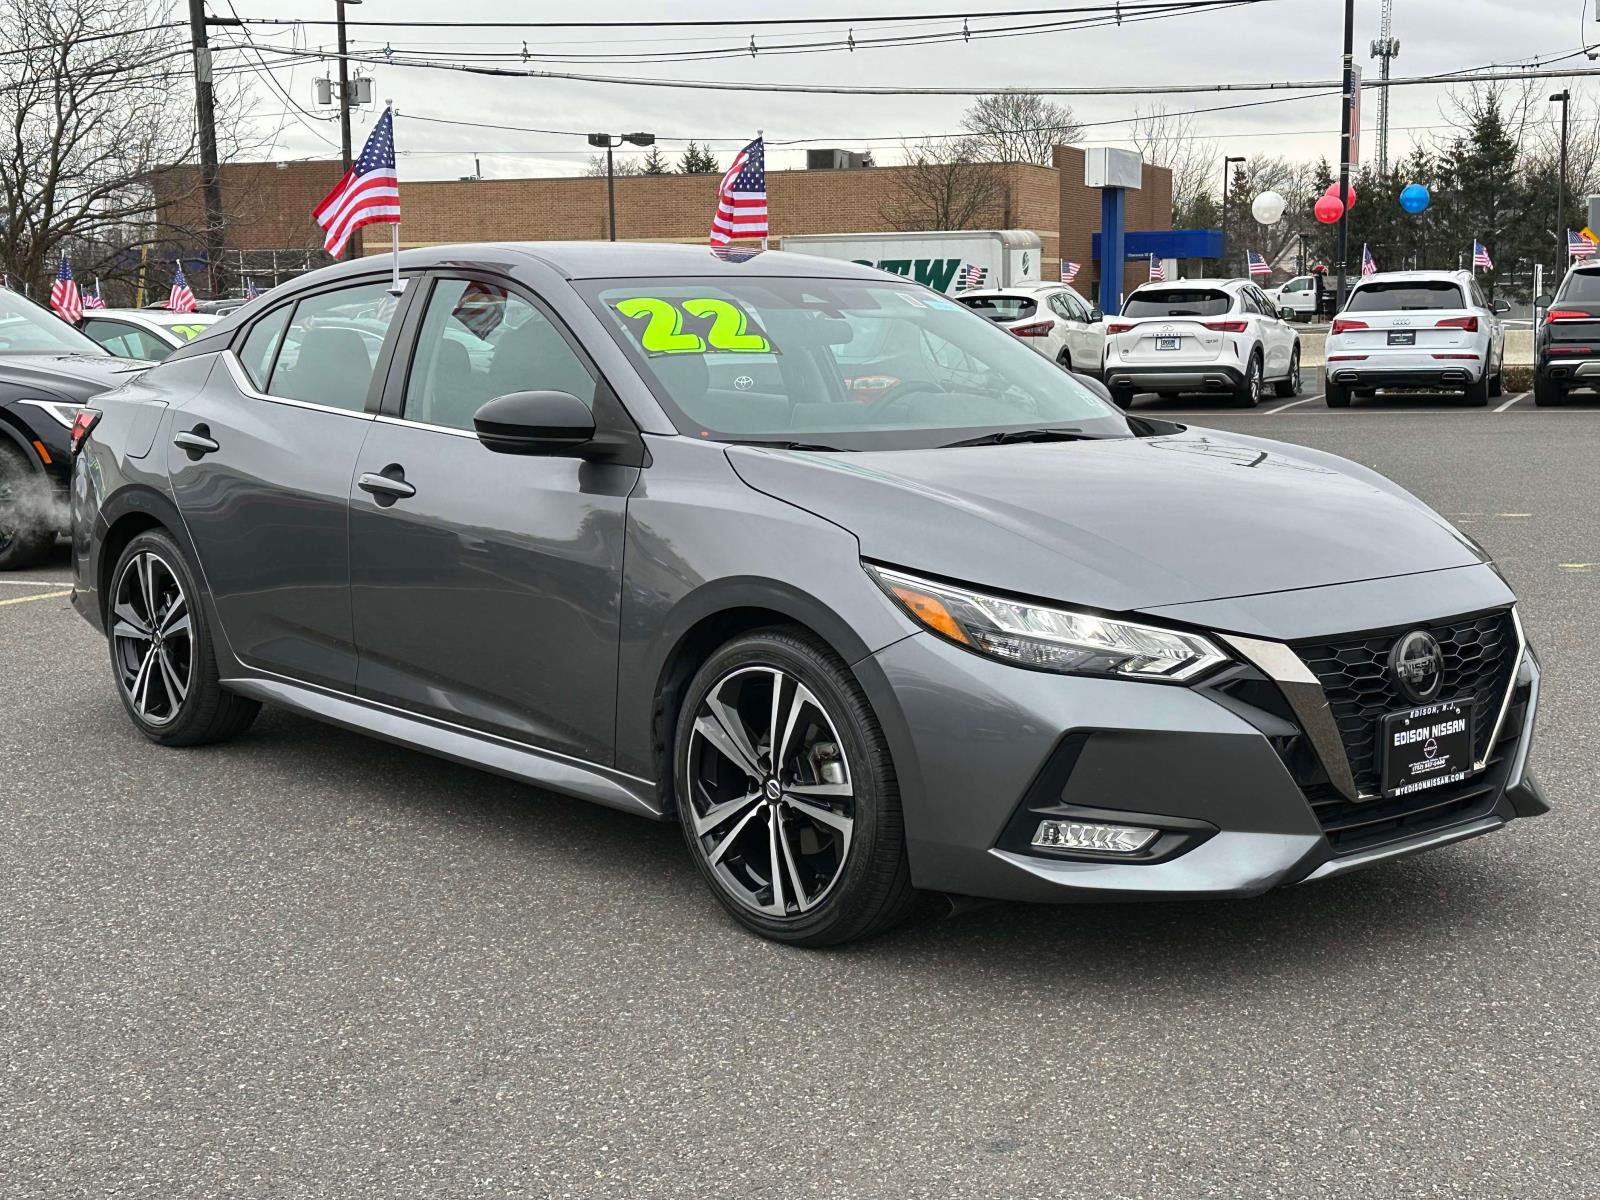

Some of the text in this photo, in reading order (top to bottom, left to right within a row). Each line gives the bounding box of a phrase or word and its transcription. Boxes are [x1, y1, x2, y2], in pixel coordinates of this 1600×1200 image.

[615, 298, 770, 353] 22
[1394, 718, 1466, 747] EDISON NISSAN
[1395, 772, 1465, 796] MYEDISONNISSAN.COM
